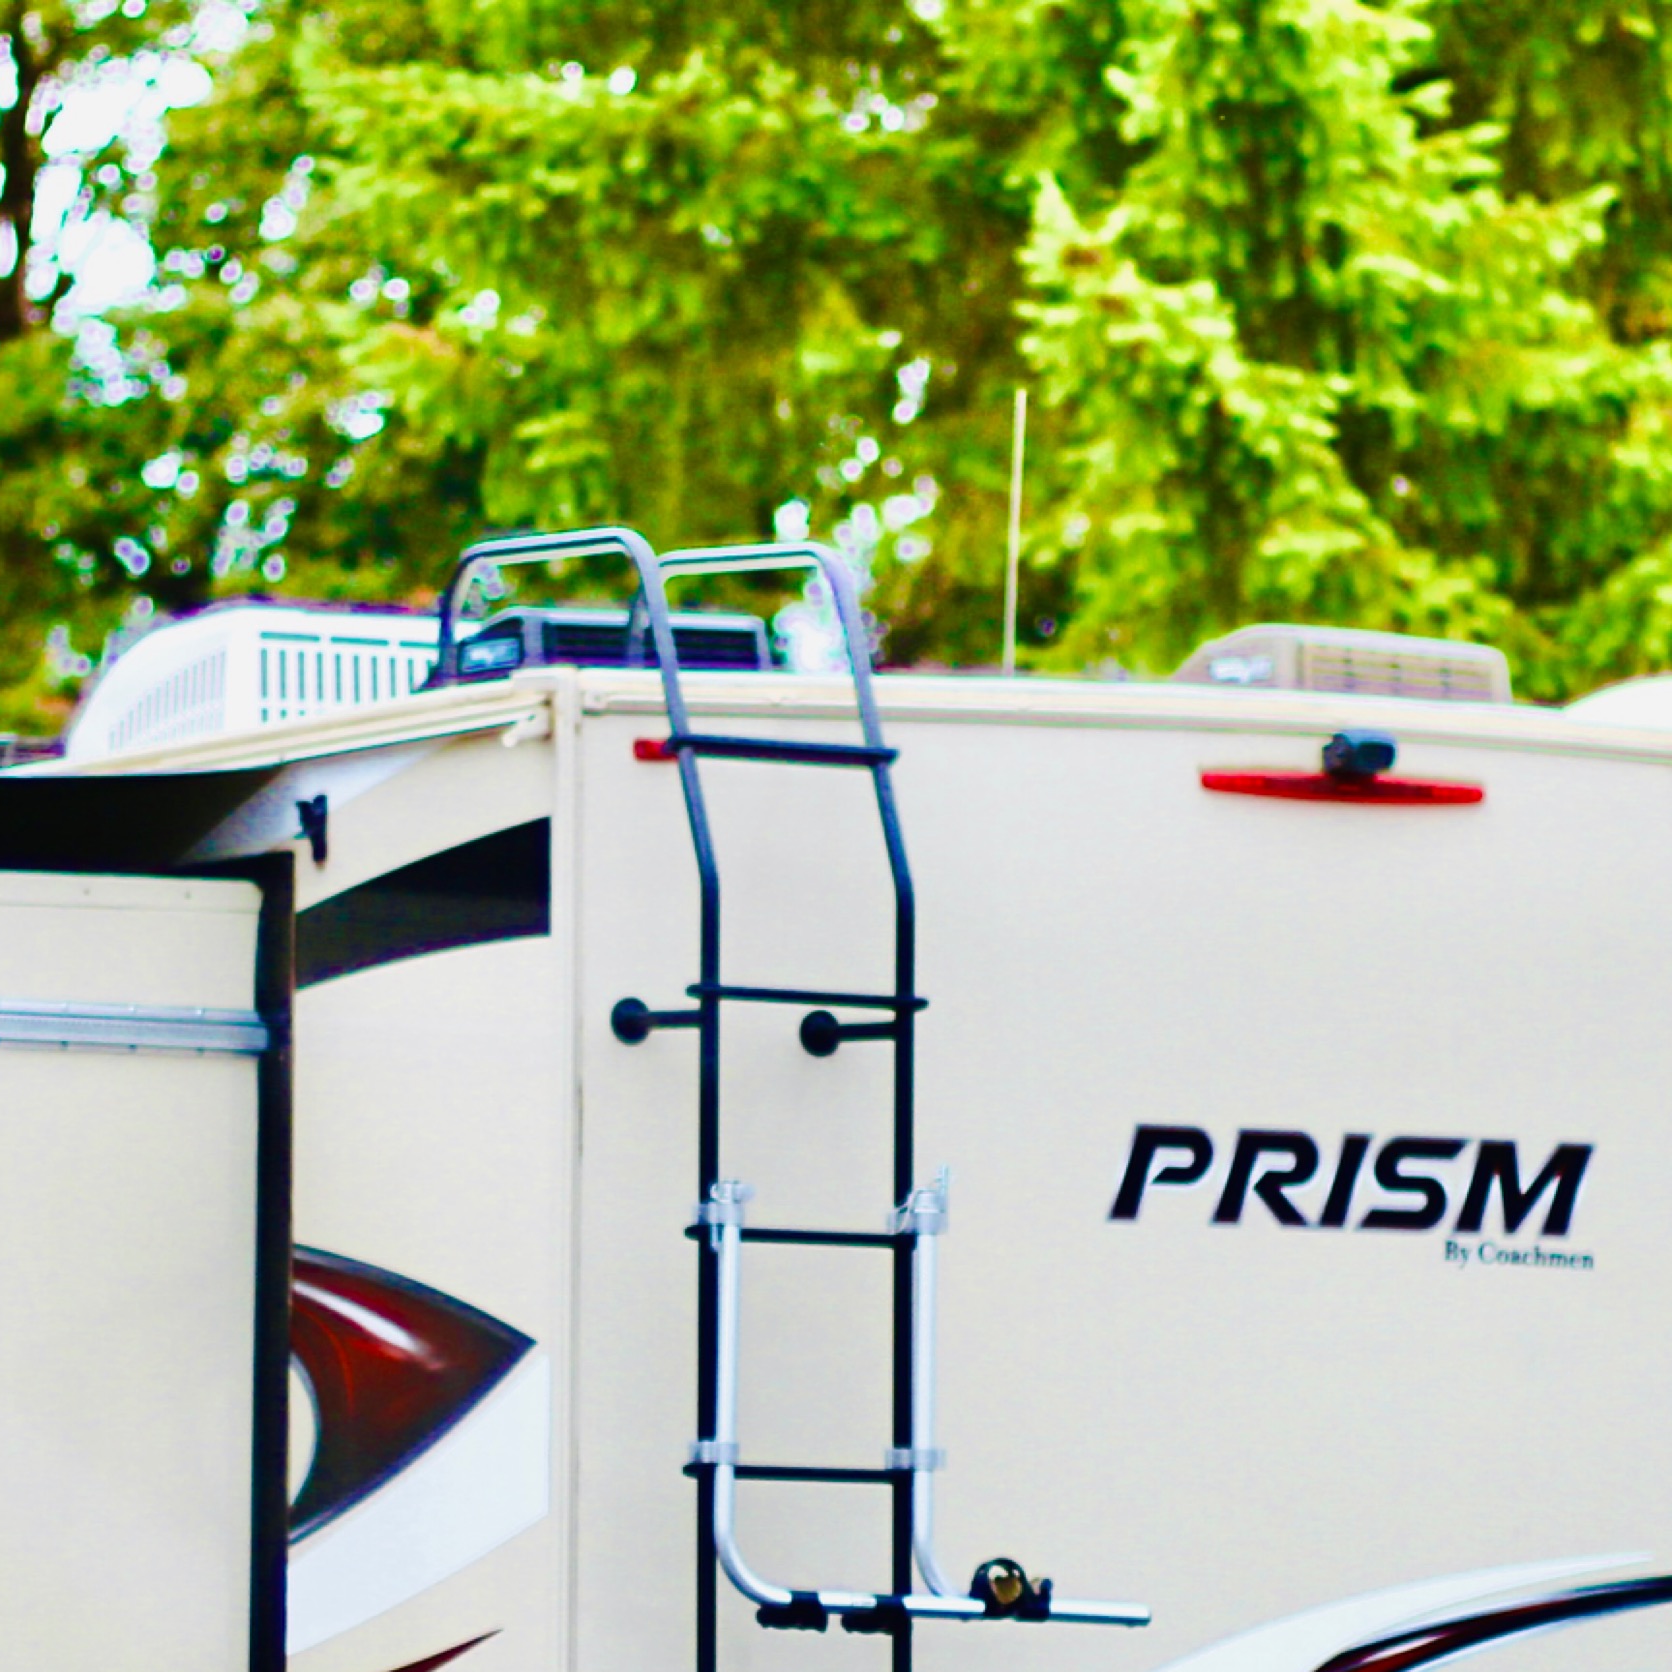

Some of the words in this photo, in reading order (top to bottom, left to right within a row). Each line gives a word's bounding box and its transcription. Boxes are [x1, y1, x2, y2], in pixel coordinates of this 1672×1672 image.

[1107, 1123, 1595, 1237] PRISM
[1444, 1239, 1470, 1270] By
[1477, 1240, 1594, 1269] Coachmen
